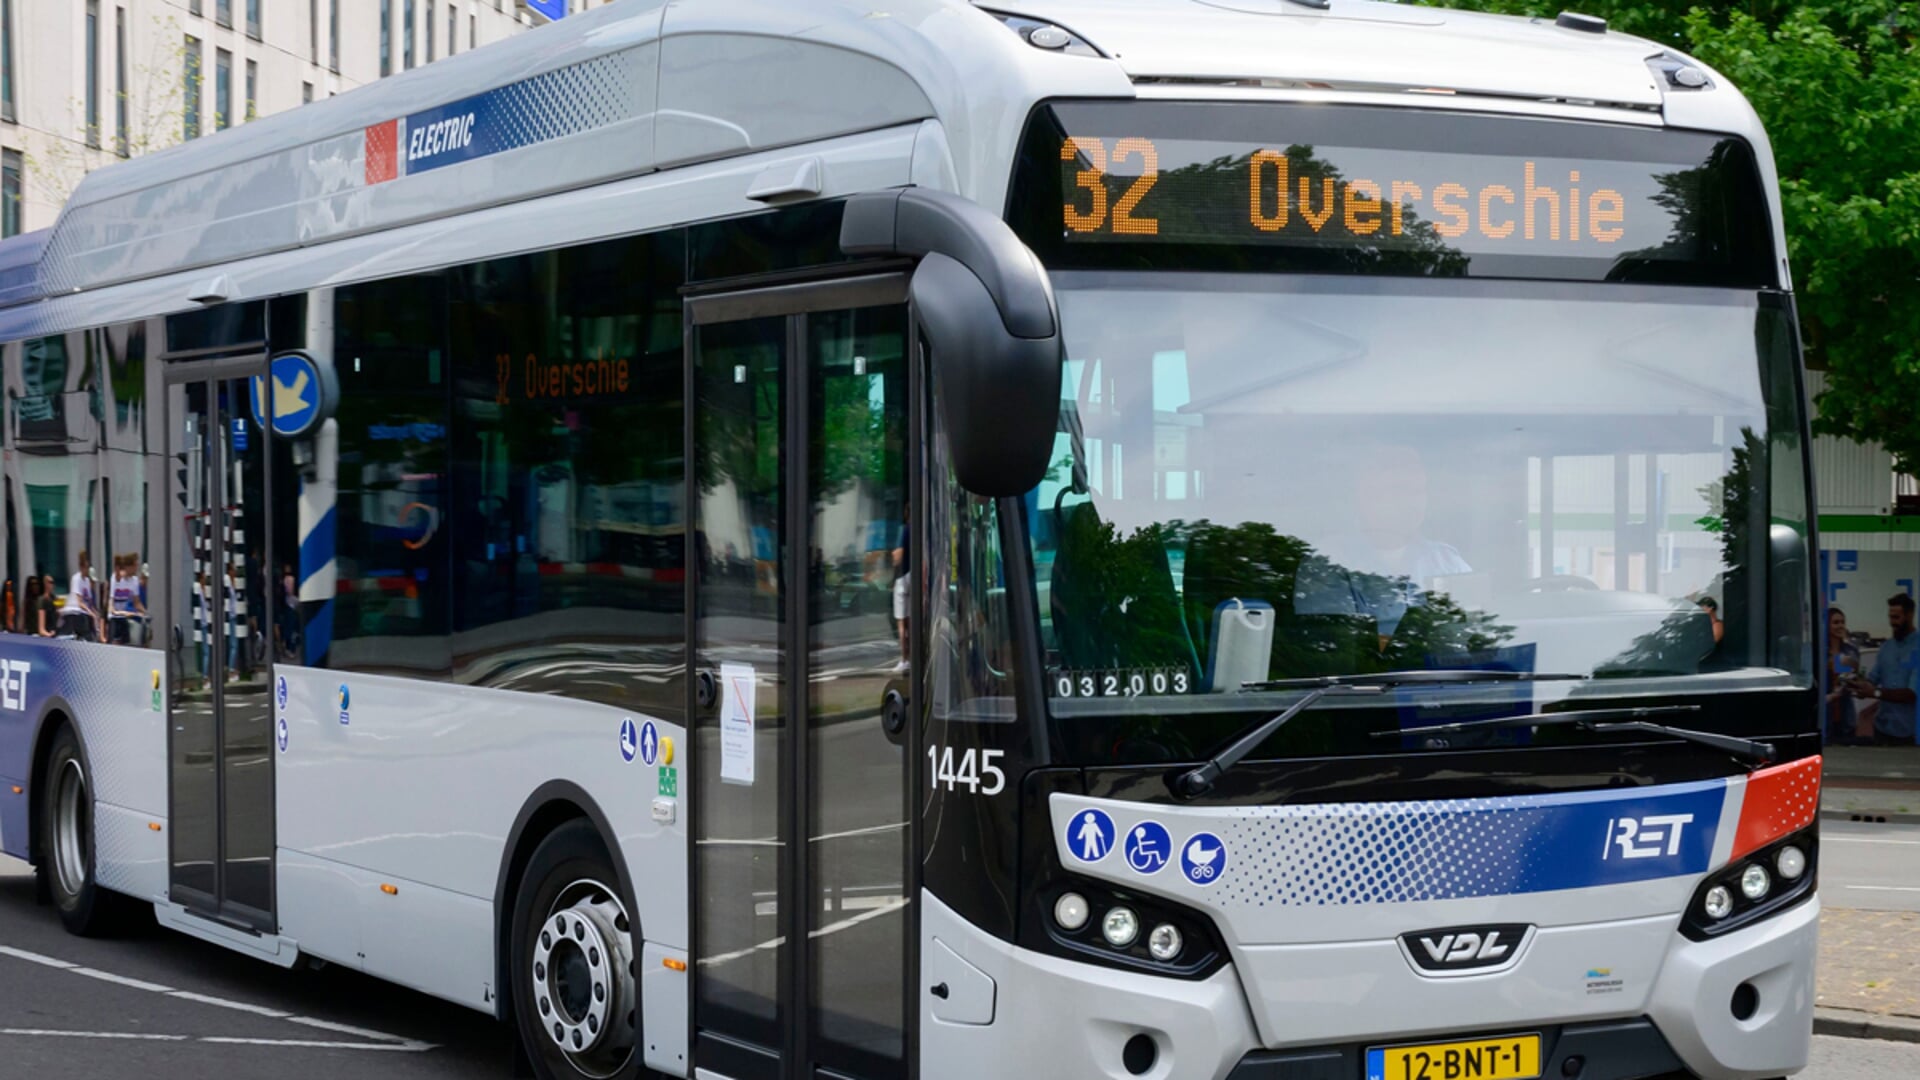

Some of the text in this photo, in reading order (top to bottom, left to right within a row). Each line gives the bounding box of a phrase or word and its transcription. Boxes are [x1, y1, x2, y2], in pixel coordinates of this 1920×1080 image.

[408, 112, 475, 161] ELECTRIC
[1061, 137, 1626, 243] 32 Overschie
[526, 345, 629, 399] Overschie
[928, 744, 1006, 796] 1445
[1602, 813, 1694, 860] RET
[1420, 931, 1509, 962] VDL
[1402, 1043, 1522, 1080] 12-BNT-1
